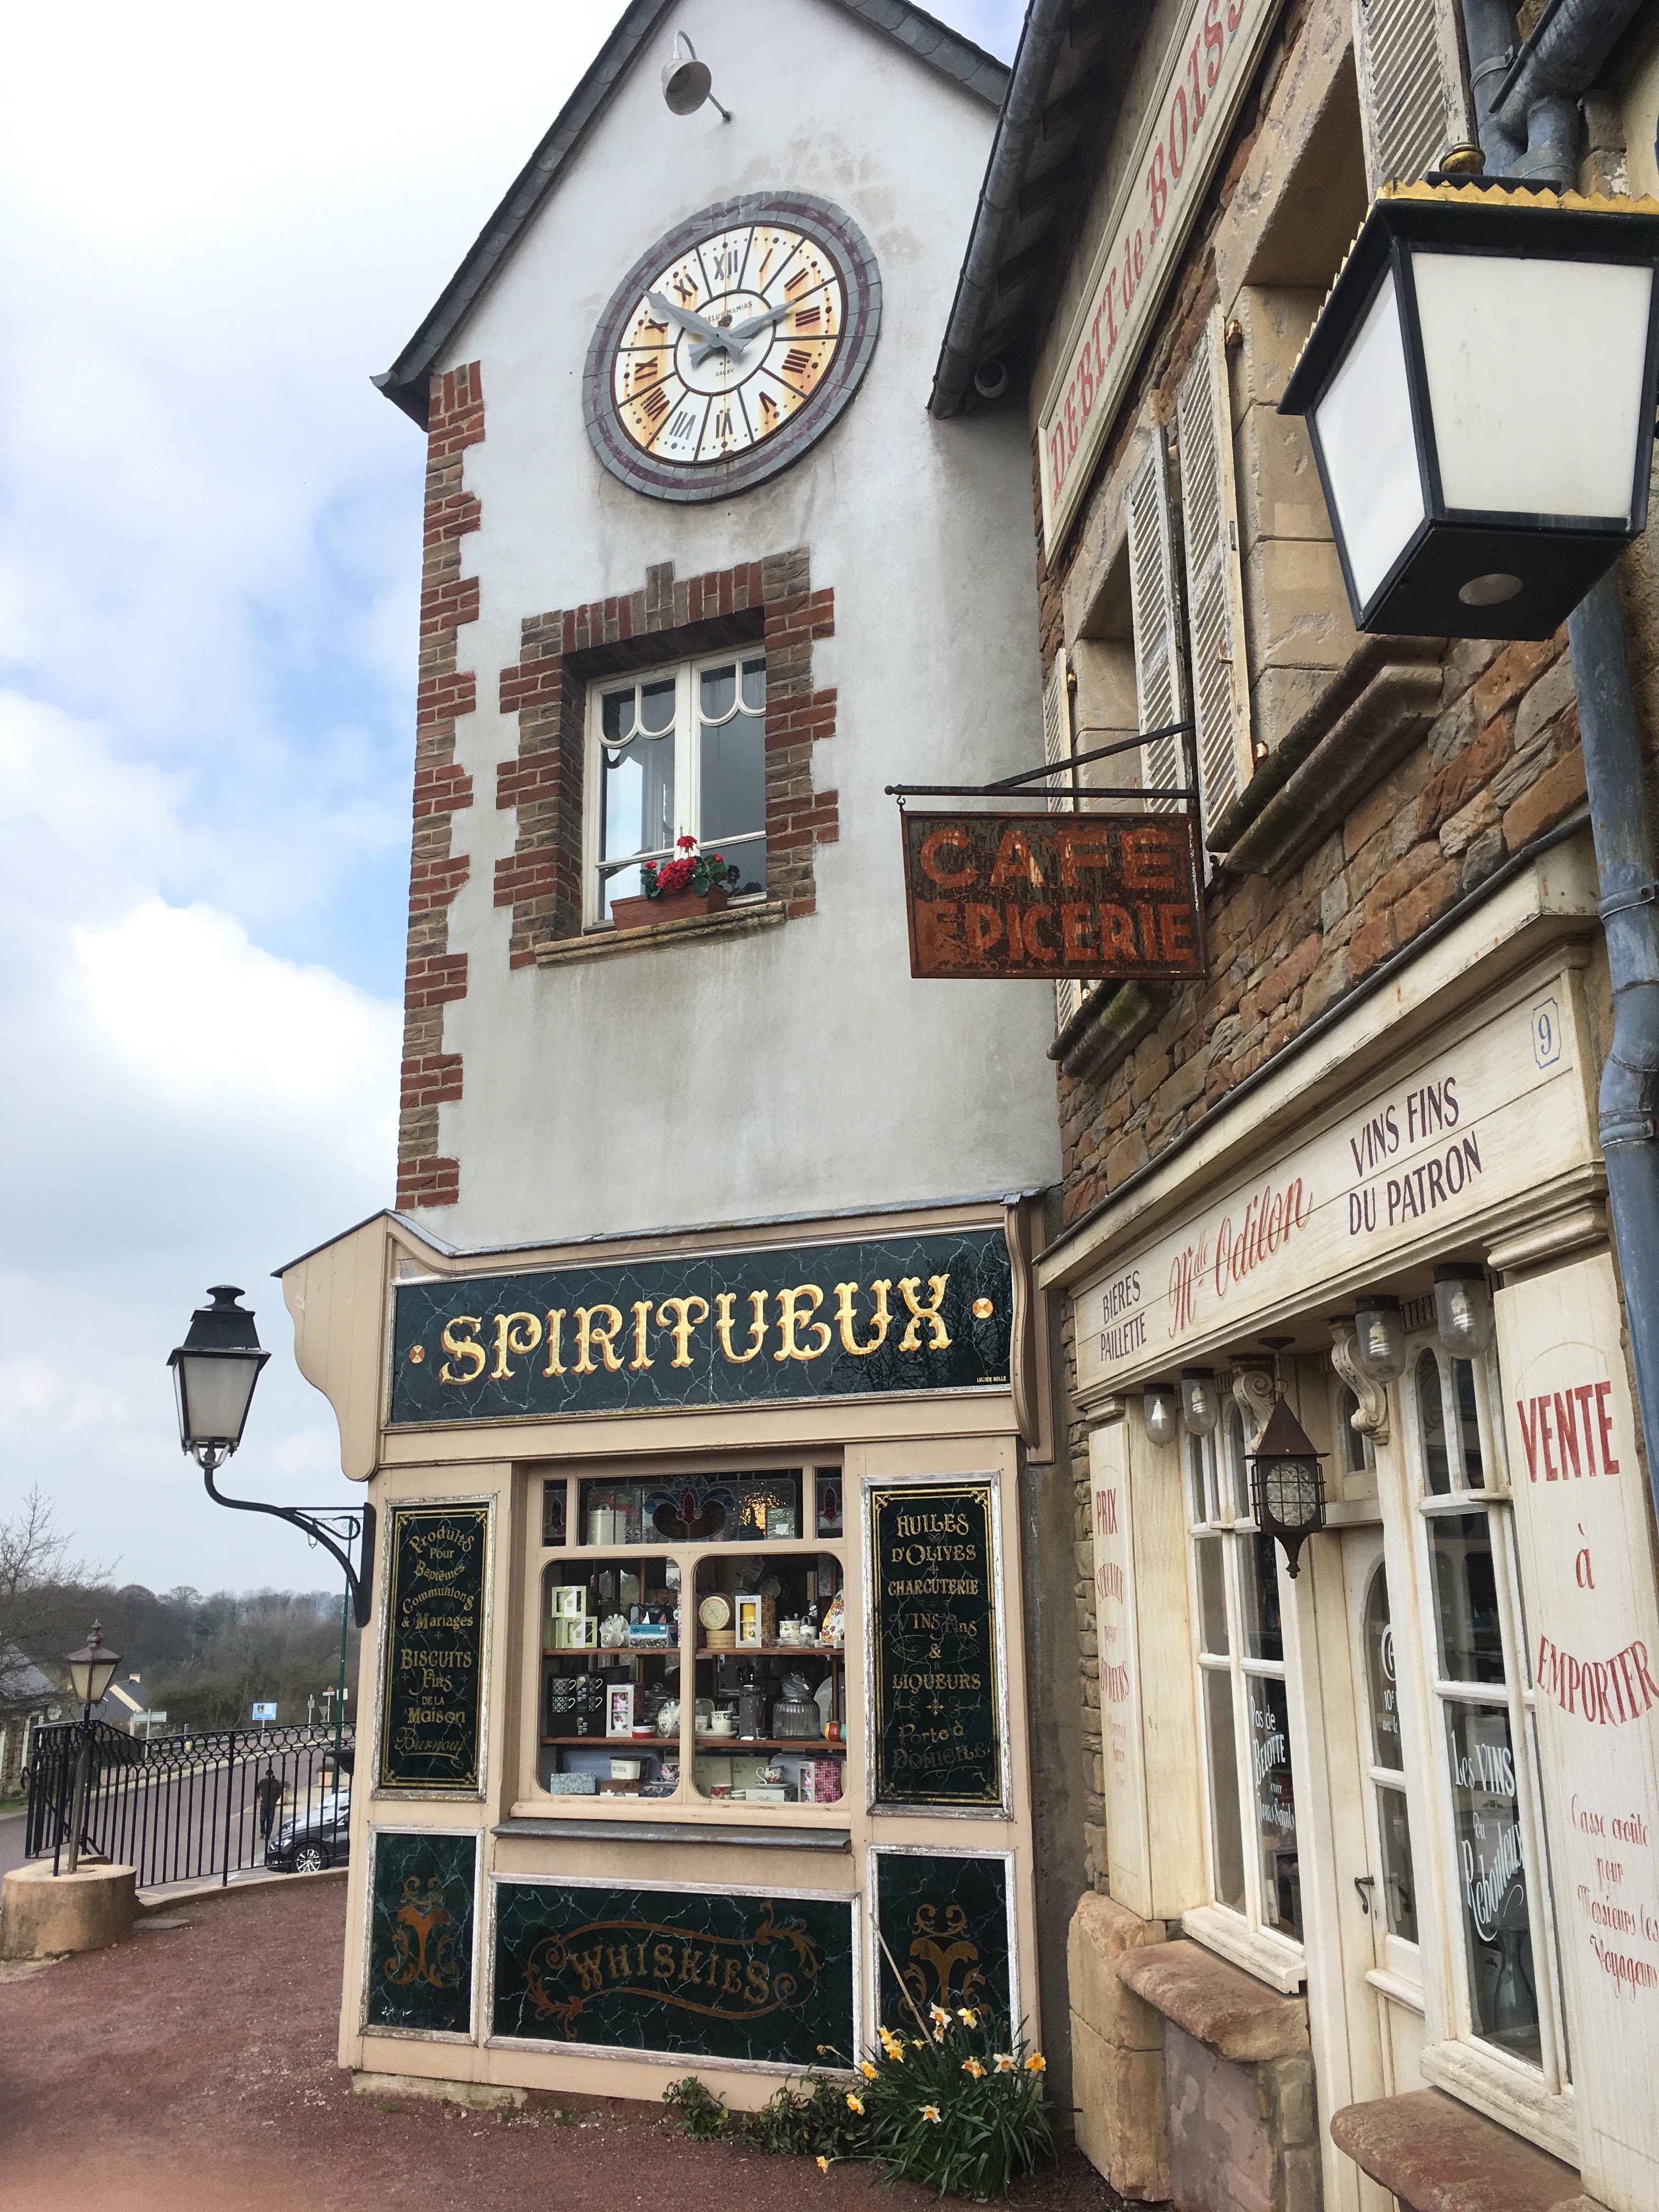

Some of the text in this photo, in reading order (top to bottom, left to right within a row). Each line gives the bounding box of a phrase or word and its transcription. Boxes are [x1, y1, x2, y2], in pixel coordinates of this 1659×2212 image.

[714, 250, 738, 280] XII
[673, 274, 698, 301] XI
[1051, 267, 1118, 503] DEBIT
[1122, 228, 1144, 312] de
[919, 828, 1175, 889] CAFE
[915, 900, 1193, 963] EPICERIE
[1538, 1013, 1552, 1056] 9
[1350, 1076, 1459, 1178] VINS FINS
[1350, 1130, 1482, 1235] DU PATRON
[1215, 1177, 1313, 1300] Odilon
[439, 1273, 953, 1386] SPIRITUEUX
[1101, 1311, 1147, 1362] PAILLETTE
[1517, 1380, 1620, 1483] VENTE
[896, 1513, 970, 1538] HUILES
[1096, 1488, 1118, 1536] PRIX
[409, 1525, 475, 1554] Produits
[430, 1548, 455, 1559] Pour
[1576, 1523, 1596, 1590] à
[413, 1559, 465, 1582] Baptêmes
[887, 1578, 979, 1596] CHARCUTERIE
[401, 1611, 474, 1630] & Mariages
[402, 1586, 475, 1614] Communions
[929, 1643, 943, 1659] &
[421, 1696, 445, 1705] DE LA
[892, 1673, 981, 1694] LIQUEURS
[1537, 1633, 1659, 1728] EMPORTER
[408, 1707, 465, 1724] Maison
[898, 1723, 950, 1745] Porte
[1250, 1695, 1276, 1731] Pas de
[1451, 1729, 1515, 1797] Les VINS
[1571, 1793, 1606, 1838] Casse
[1596, 1857, 1623, 1892] pour
[1577, 1884, 1659, 1942] Messieurs les
[569, 1943, 769, 2005] WHISKIES
[1590, 1934, 1658, 2004] Voyageurs
